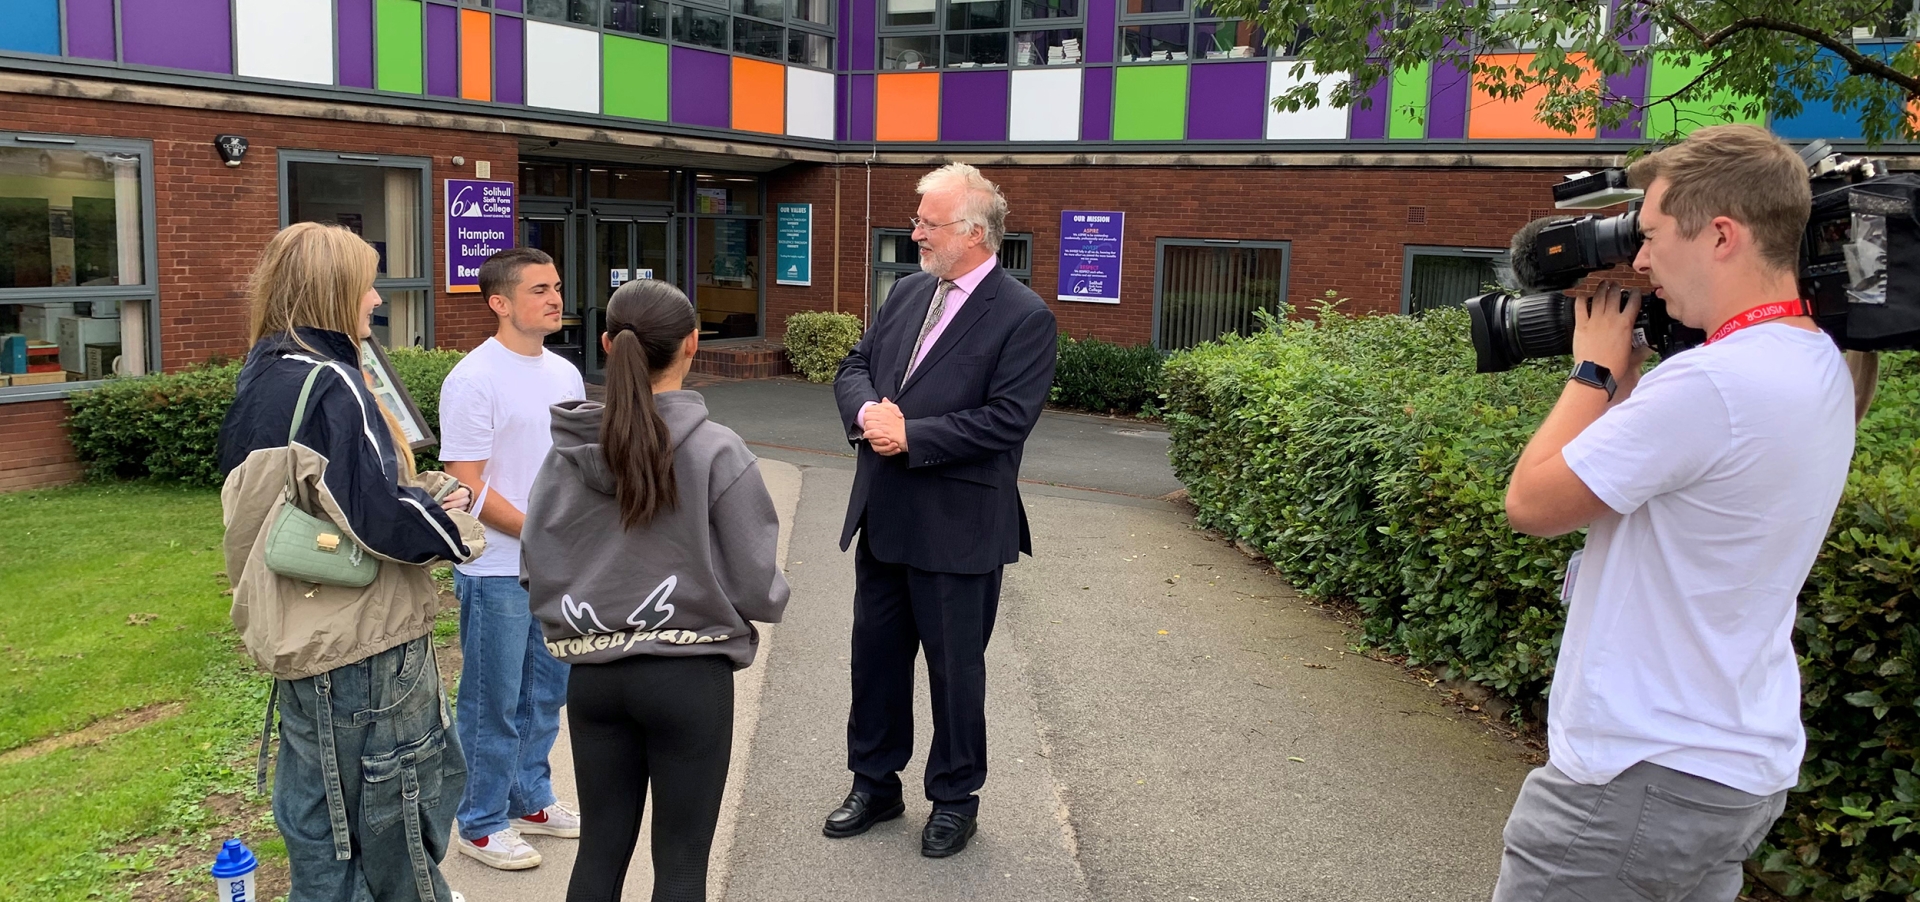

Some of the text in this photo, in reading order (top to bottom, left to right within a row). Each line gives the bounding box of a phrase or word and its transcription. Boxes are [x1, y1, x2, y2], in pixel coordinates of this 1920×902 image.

[483, 187, 511, 197] Solihull
[483, 204, 511, 215] College
[1086, 215, 1110, 223] MISSION
[458, 227, 505, 243] Hampton
[1745, 305, 1786, 322] VISITOR
[543, 631, 626, 658] broken
